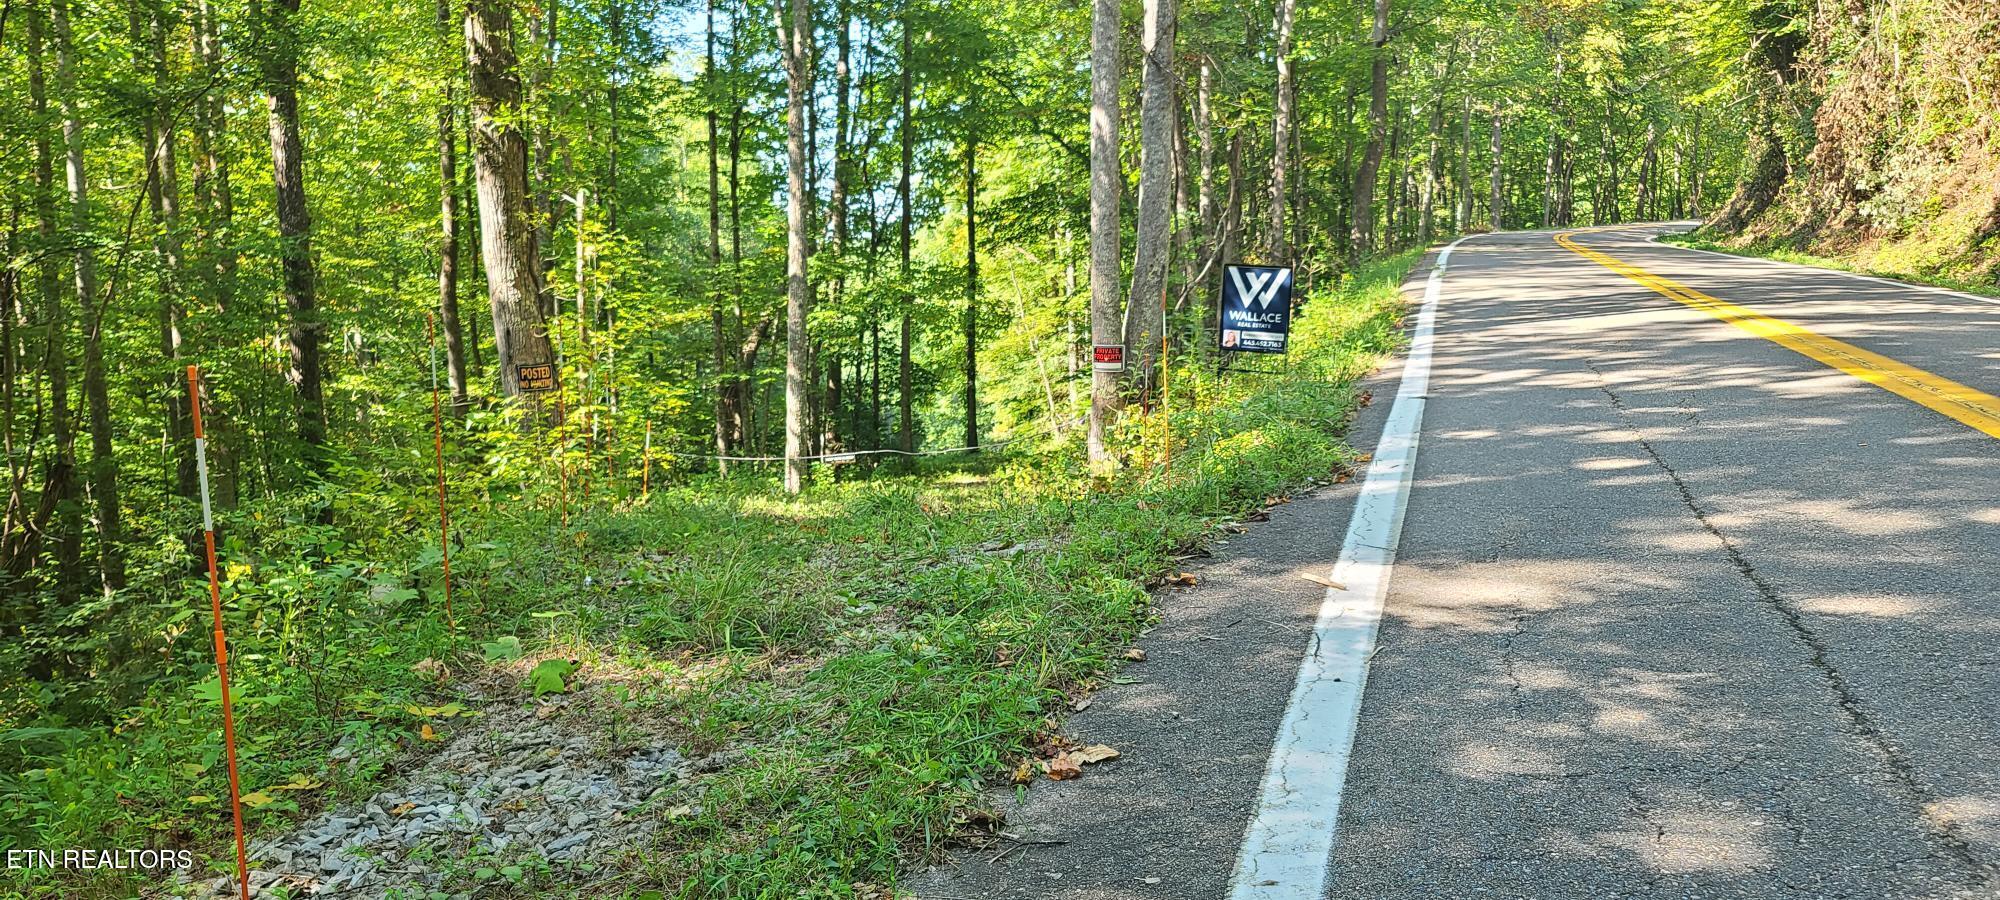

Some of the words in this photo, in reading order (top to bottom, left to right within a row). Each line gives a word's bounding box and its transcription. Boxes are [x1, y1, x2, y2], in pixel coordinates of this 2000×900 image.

[1229, 311, 1282, 323] WALLACE
[521, 366, 551, 380] POSTED
[519, 380, 529, 389] NO
